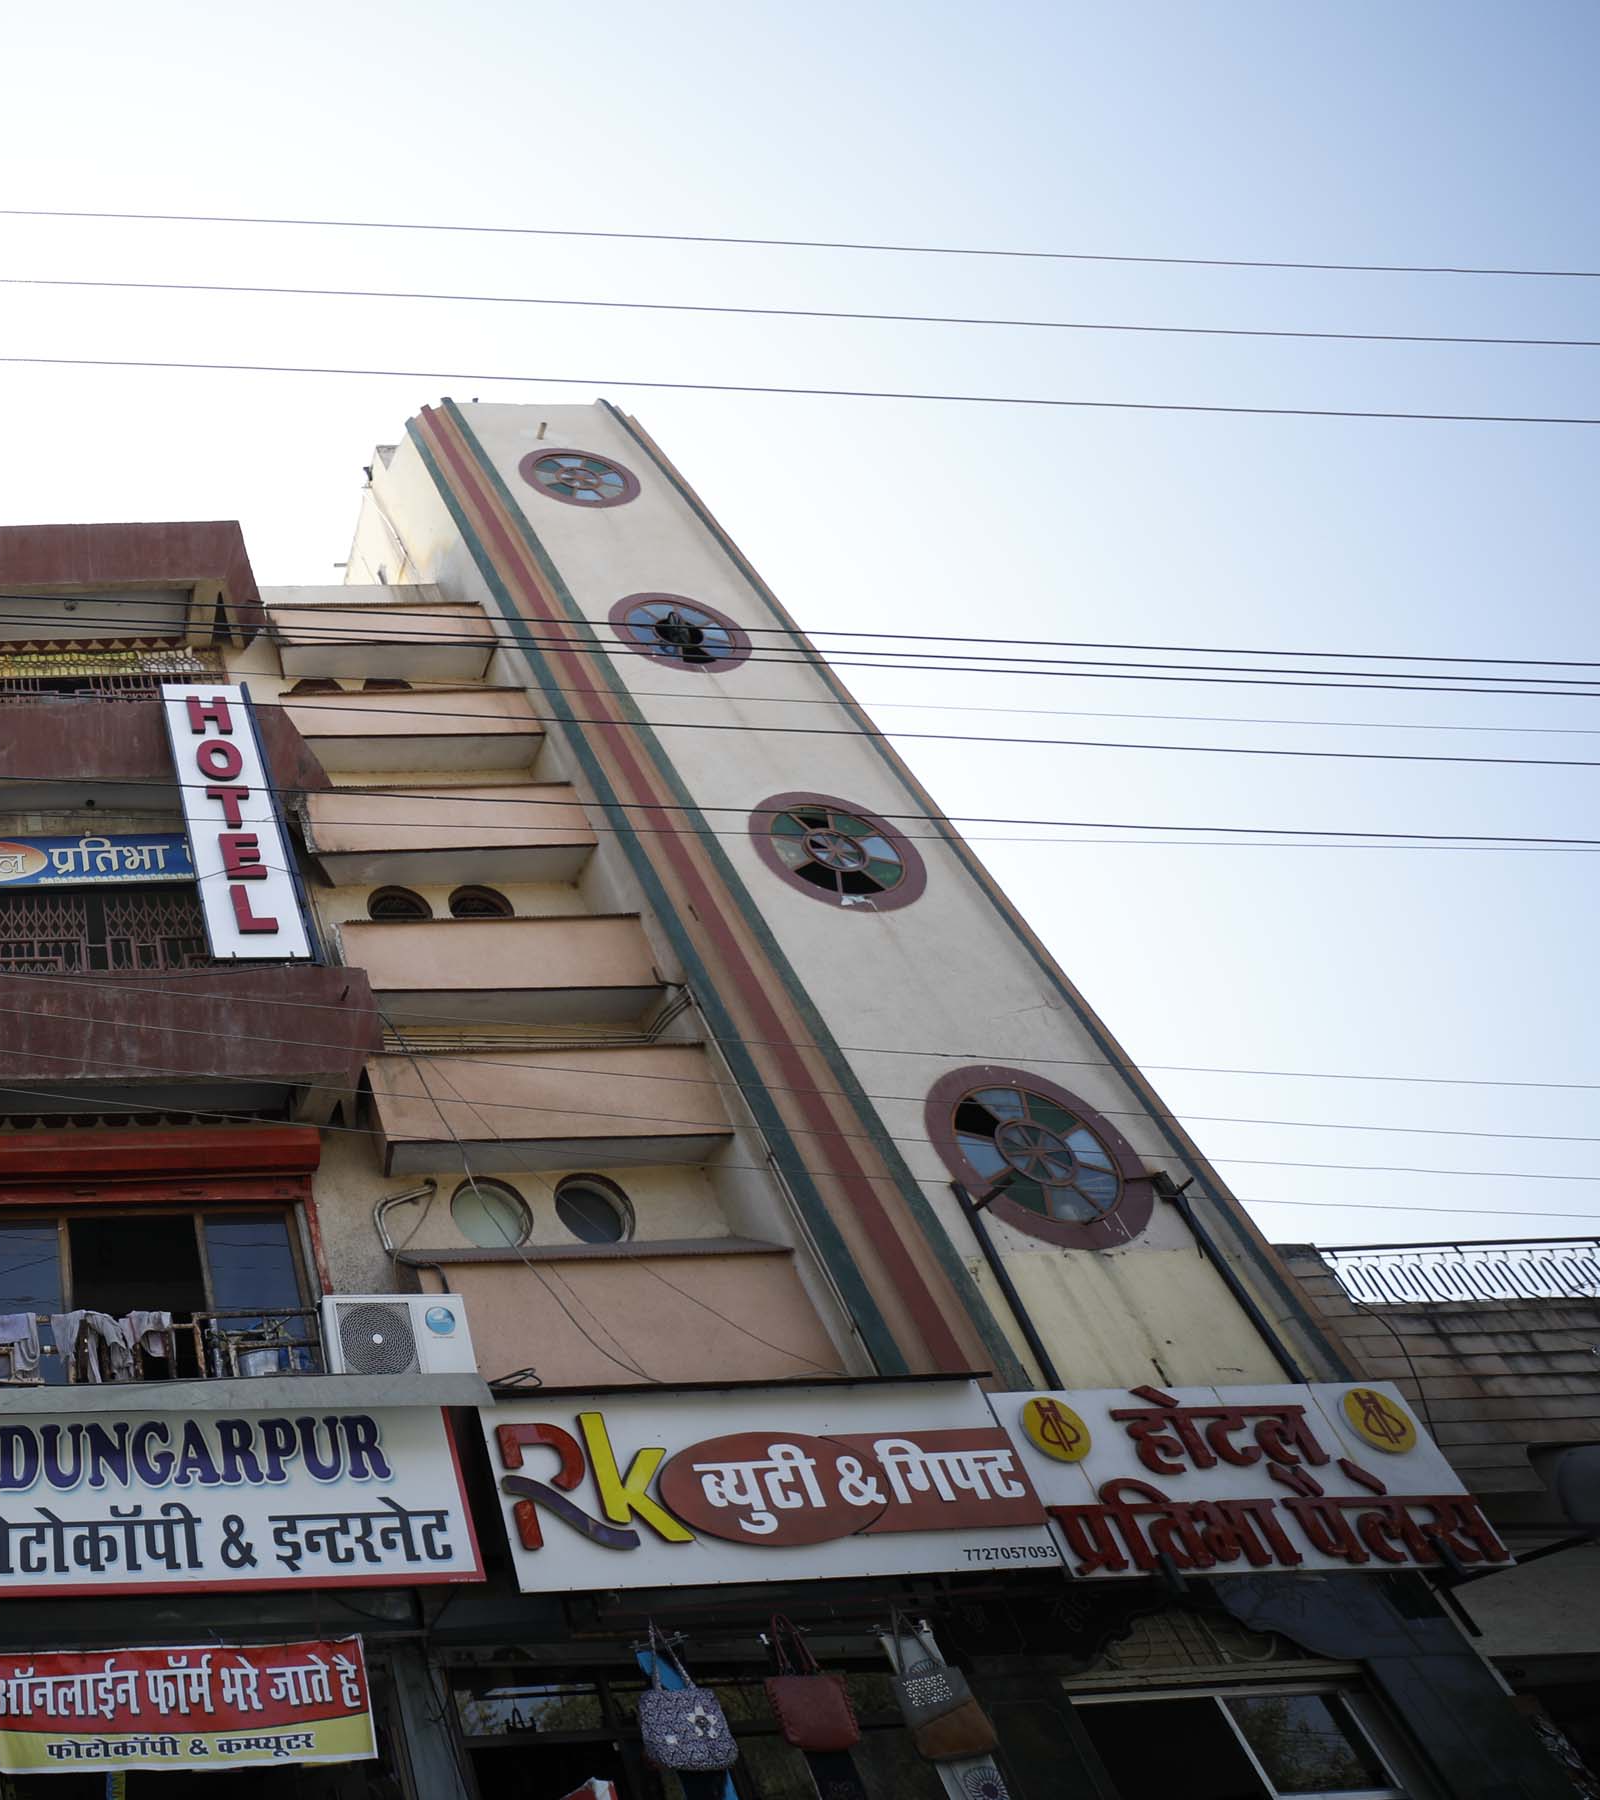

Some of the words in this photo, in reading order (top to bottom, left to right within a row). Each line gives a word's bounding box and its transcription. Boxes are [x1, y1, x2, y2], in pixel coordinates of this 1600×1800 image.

[185, 695, 279, 935] HOTEL
[48, 837, 170, 875] प्रतिभा
[1110, 1385, 1331, 1476] होटल
[837, 1455, 888, 1505] &
[220, 1514, 258, 1570] &
[268, 1497, 455, 1573] इन्टरनेट
[1048, 1477, 1303, 1576] प्रतिभा
[1267, 1457, 1511, 1565] पैलेस
[962, 1545, 1058, 1561] 7727057093
[146, 1653, 215, 1714] फॉर्म
[220, 1656, 264, 1712] भरे
[266, 1653, 334, 1707] जाते
[331, 1653, 362, 1709] है
[46, 1736, 181, 1760] फोटोकॉपी
[188, 1738, 209, 1757] &
